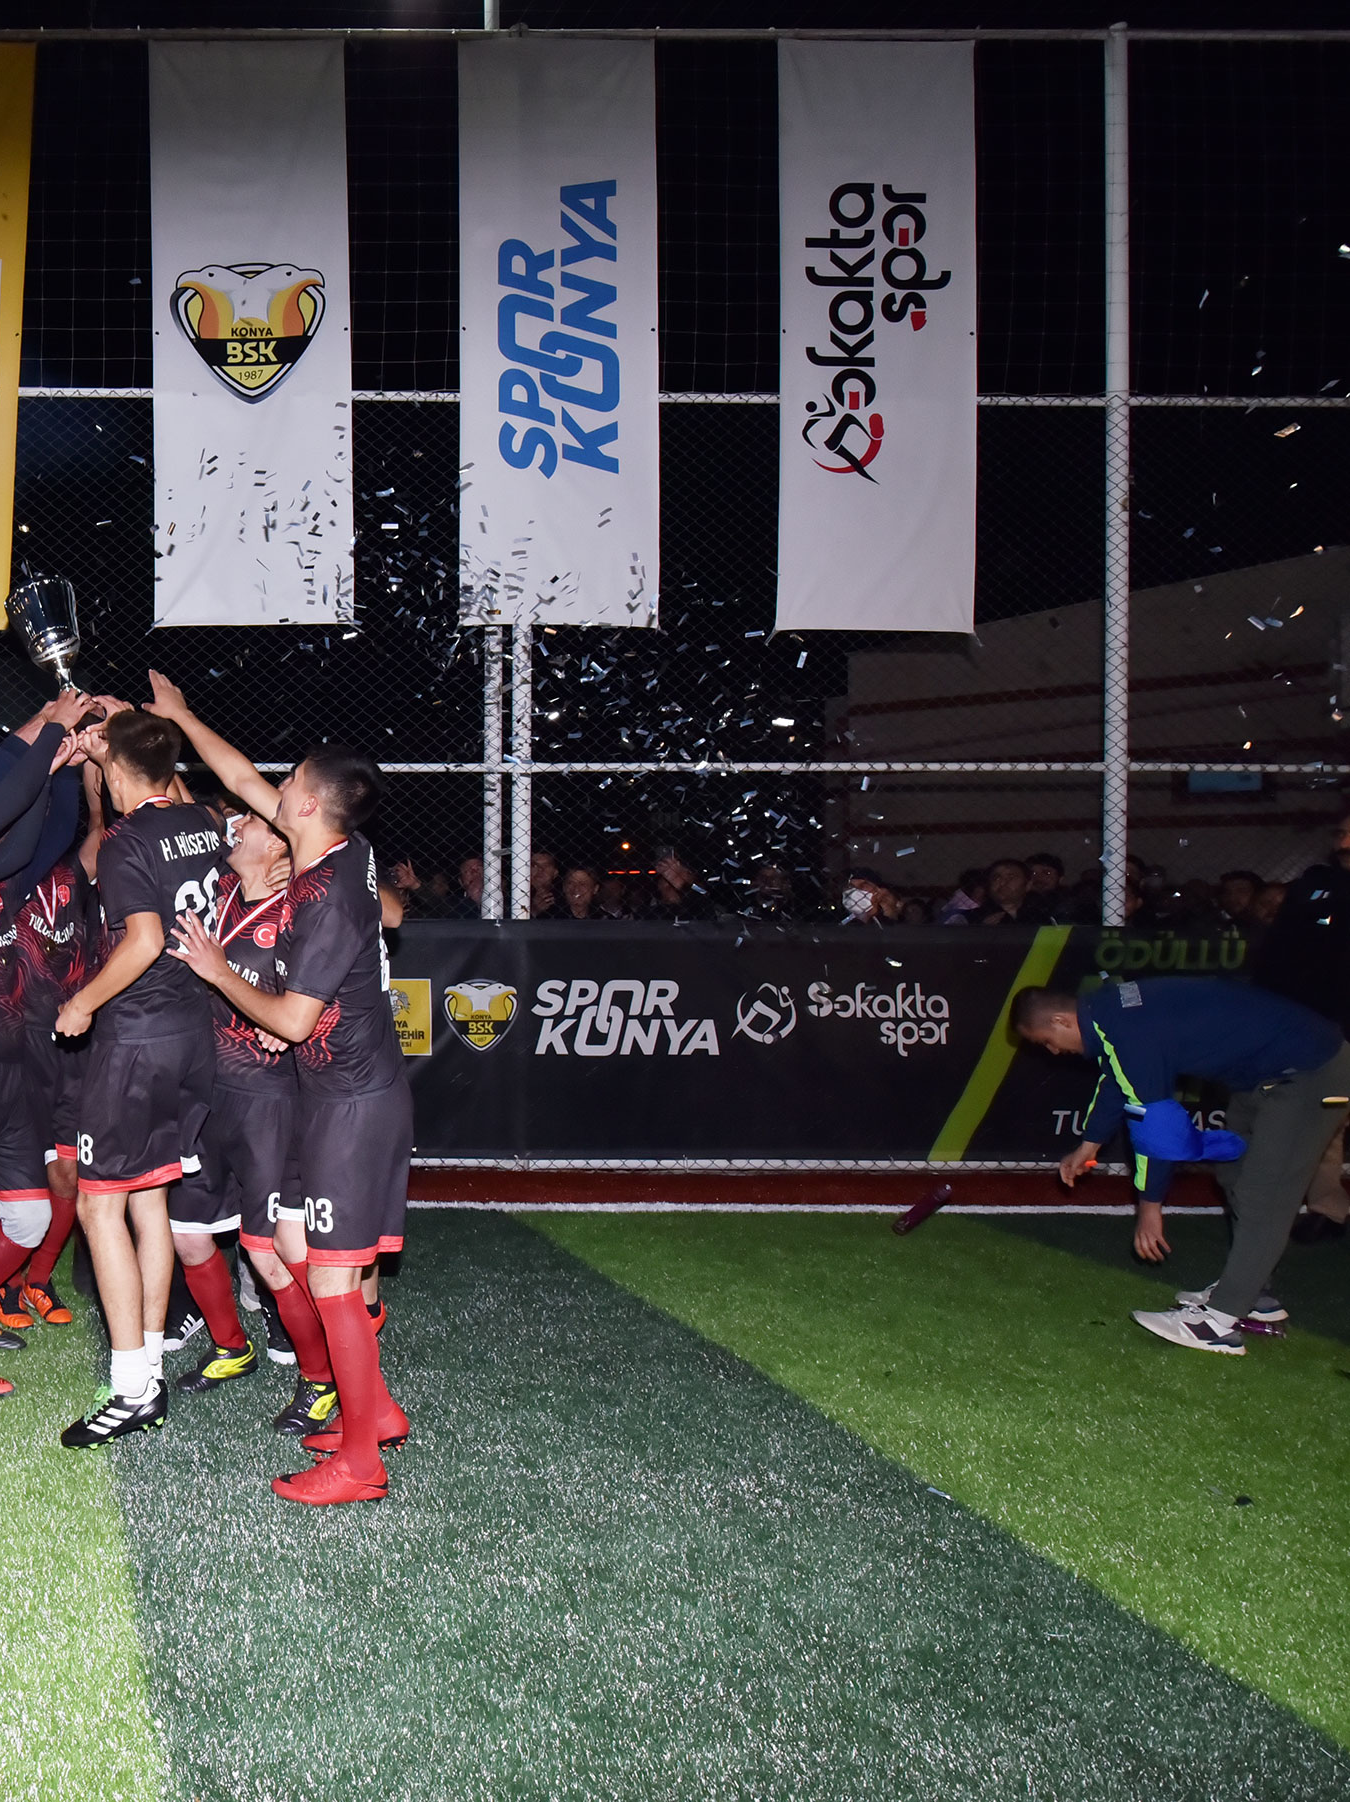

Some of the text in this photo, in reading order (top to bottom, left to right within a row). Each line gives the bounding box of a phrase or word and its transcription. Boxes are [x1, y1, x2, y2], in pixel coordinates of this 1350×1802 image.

[230, 326, 275, 338] KONYA
[550, 178, 621, 476] KONYA
[225, 340, 279, 364] BSK
[497, 237, 568, 481] SPOR
[237, 369, 265, 382] 1987
[159, 837, 179, 862] H.
[1094, 929, 1247, 970] ÖDÜLLÜ
[530, 979, 680, 1022] SPOR
[807, 981, 950, 1019] Sokakta
[468, 1022, 495, 1034] BSK
[534, 1012, 721, 1057] KONYA
[879, 1020, 950, 1057] spor
[304, 1196, 334, 1234] 03
